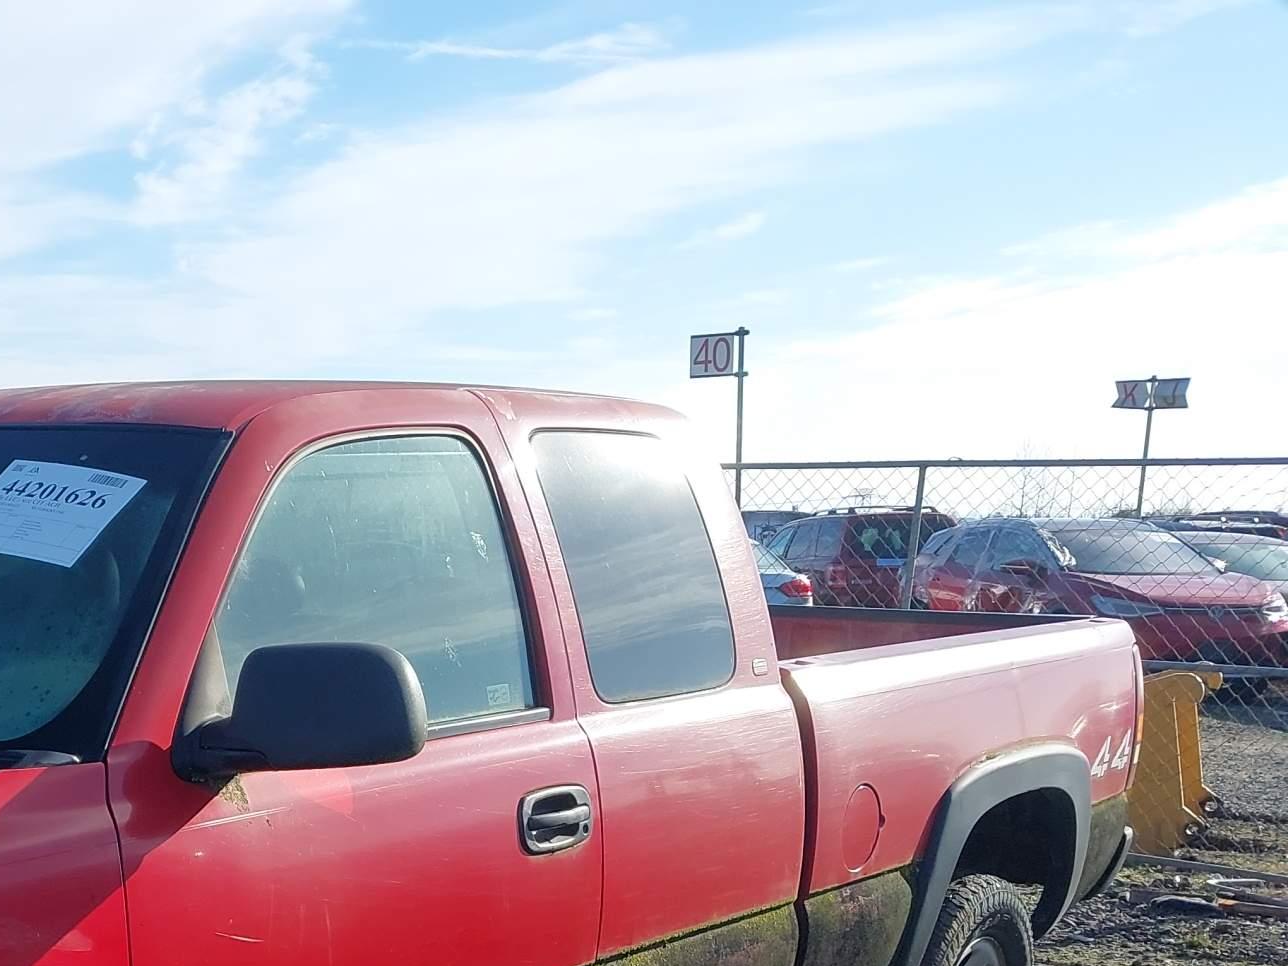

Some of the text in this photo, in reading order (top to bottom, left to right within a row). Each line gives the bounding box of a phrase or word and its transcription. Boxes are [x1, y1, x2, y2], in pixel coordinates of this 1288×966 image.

[693, 337, 731, 373] 40
[1120, 382, 1139, 406] K
[2, 479, 113, 510] 44201626
